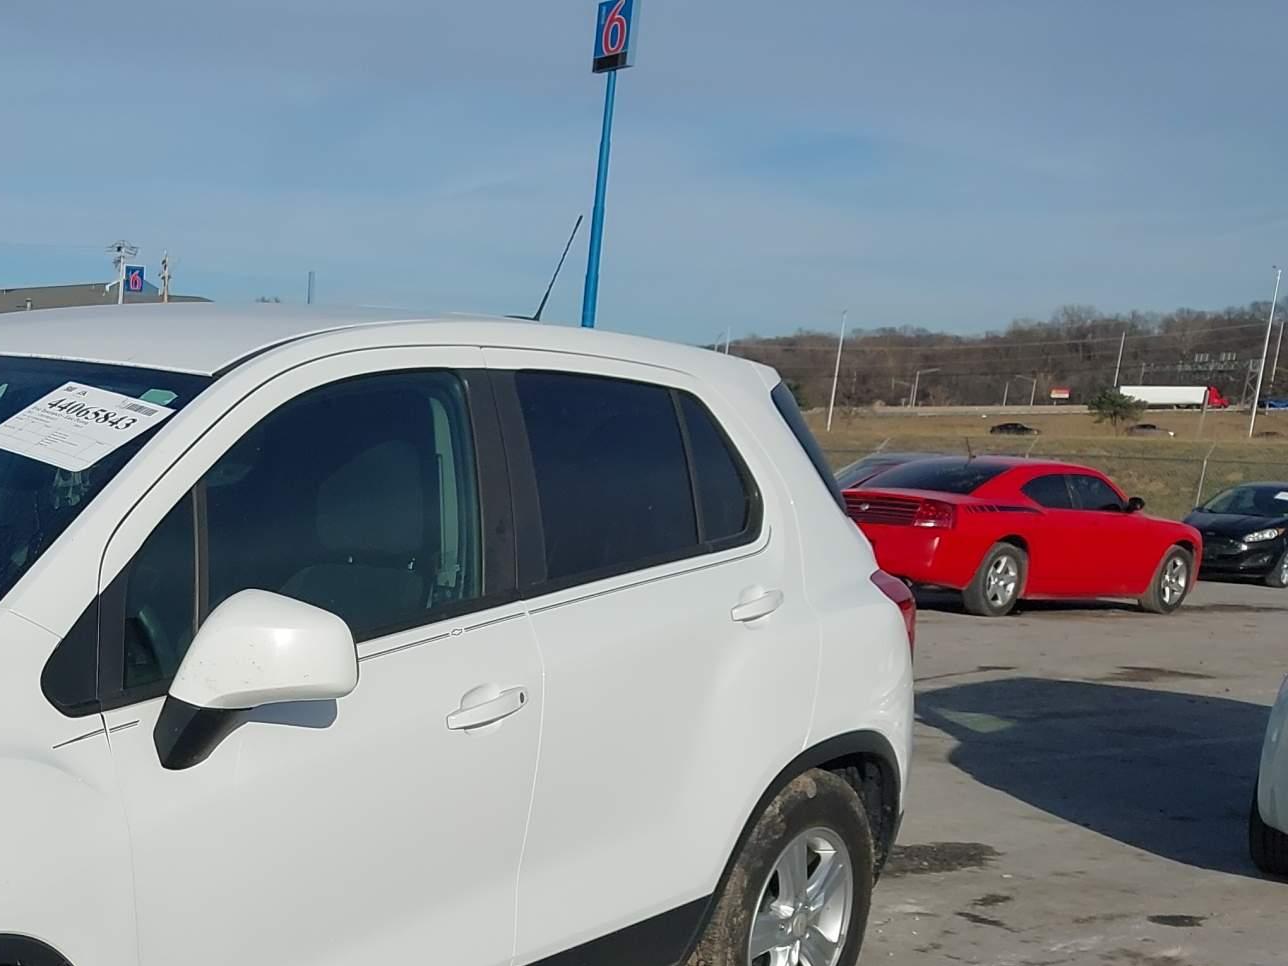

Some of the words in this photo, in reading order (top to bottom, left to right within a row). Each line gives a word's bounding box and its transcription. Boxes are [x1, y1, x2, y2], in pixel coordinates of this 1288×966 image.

[602, 0, 626, 56] 6
[130, 270, 142, 290] 6
[47, 398, 138, 430] 44065843
